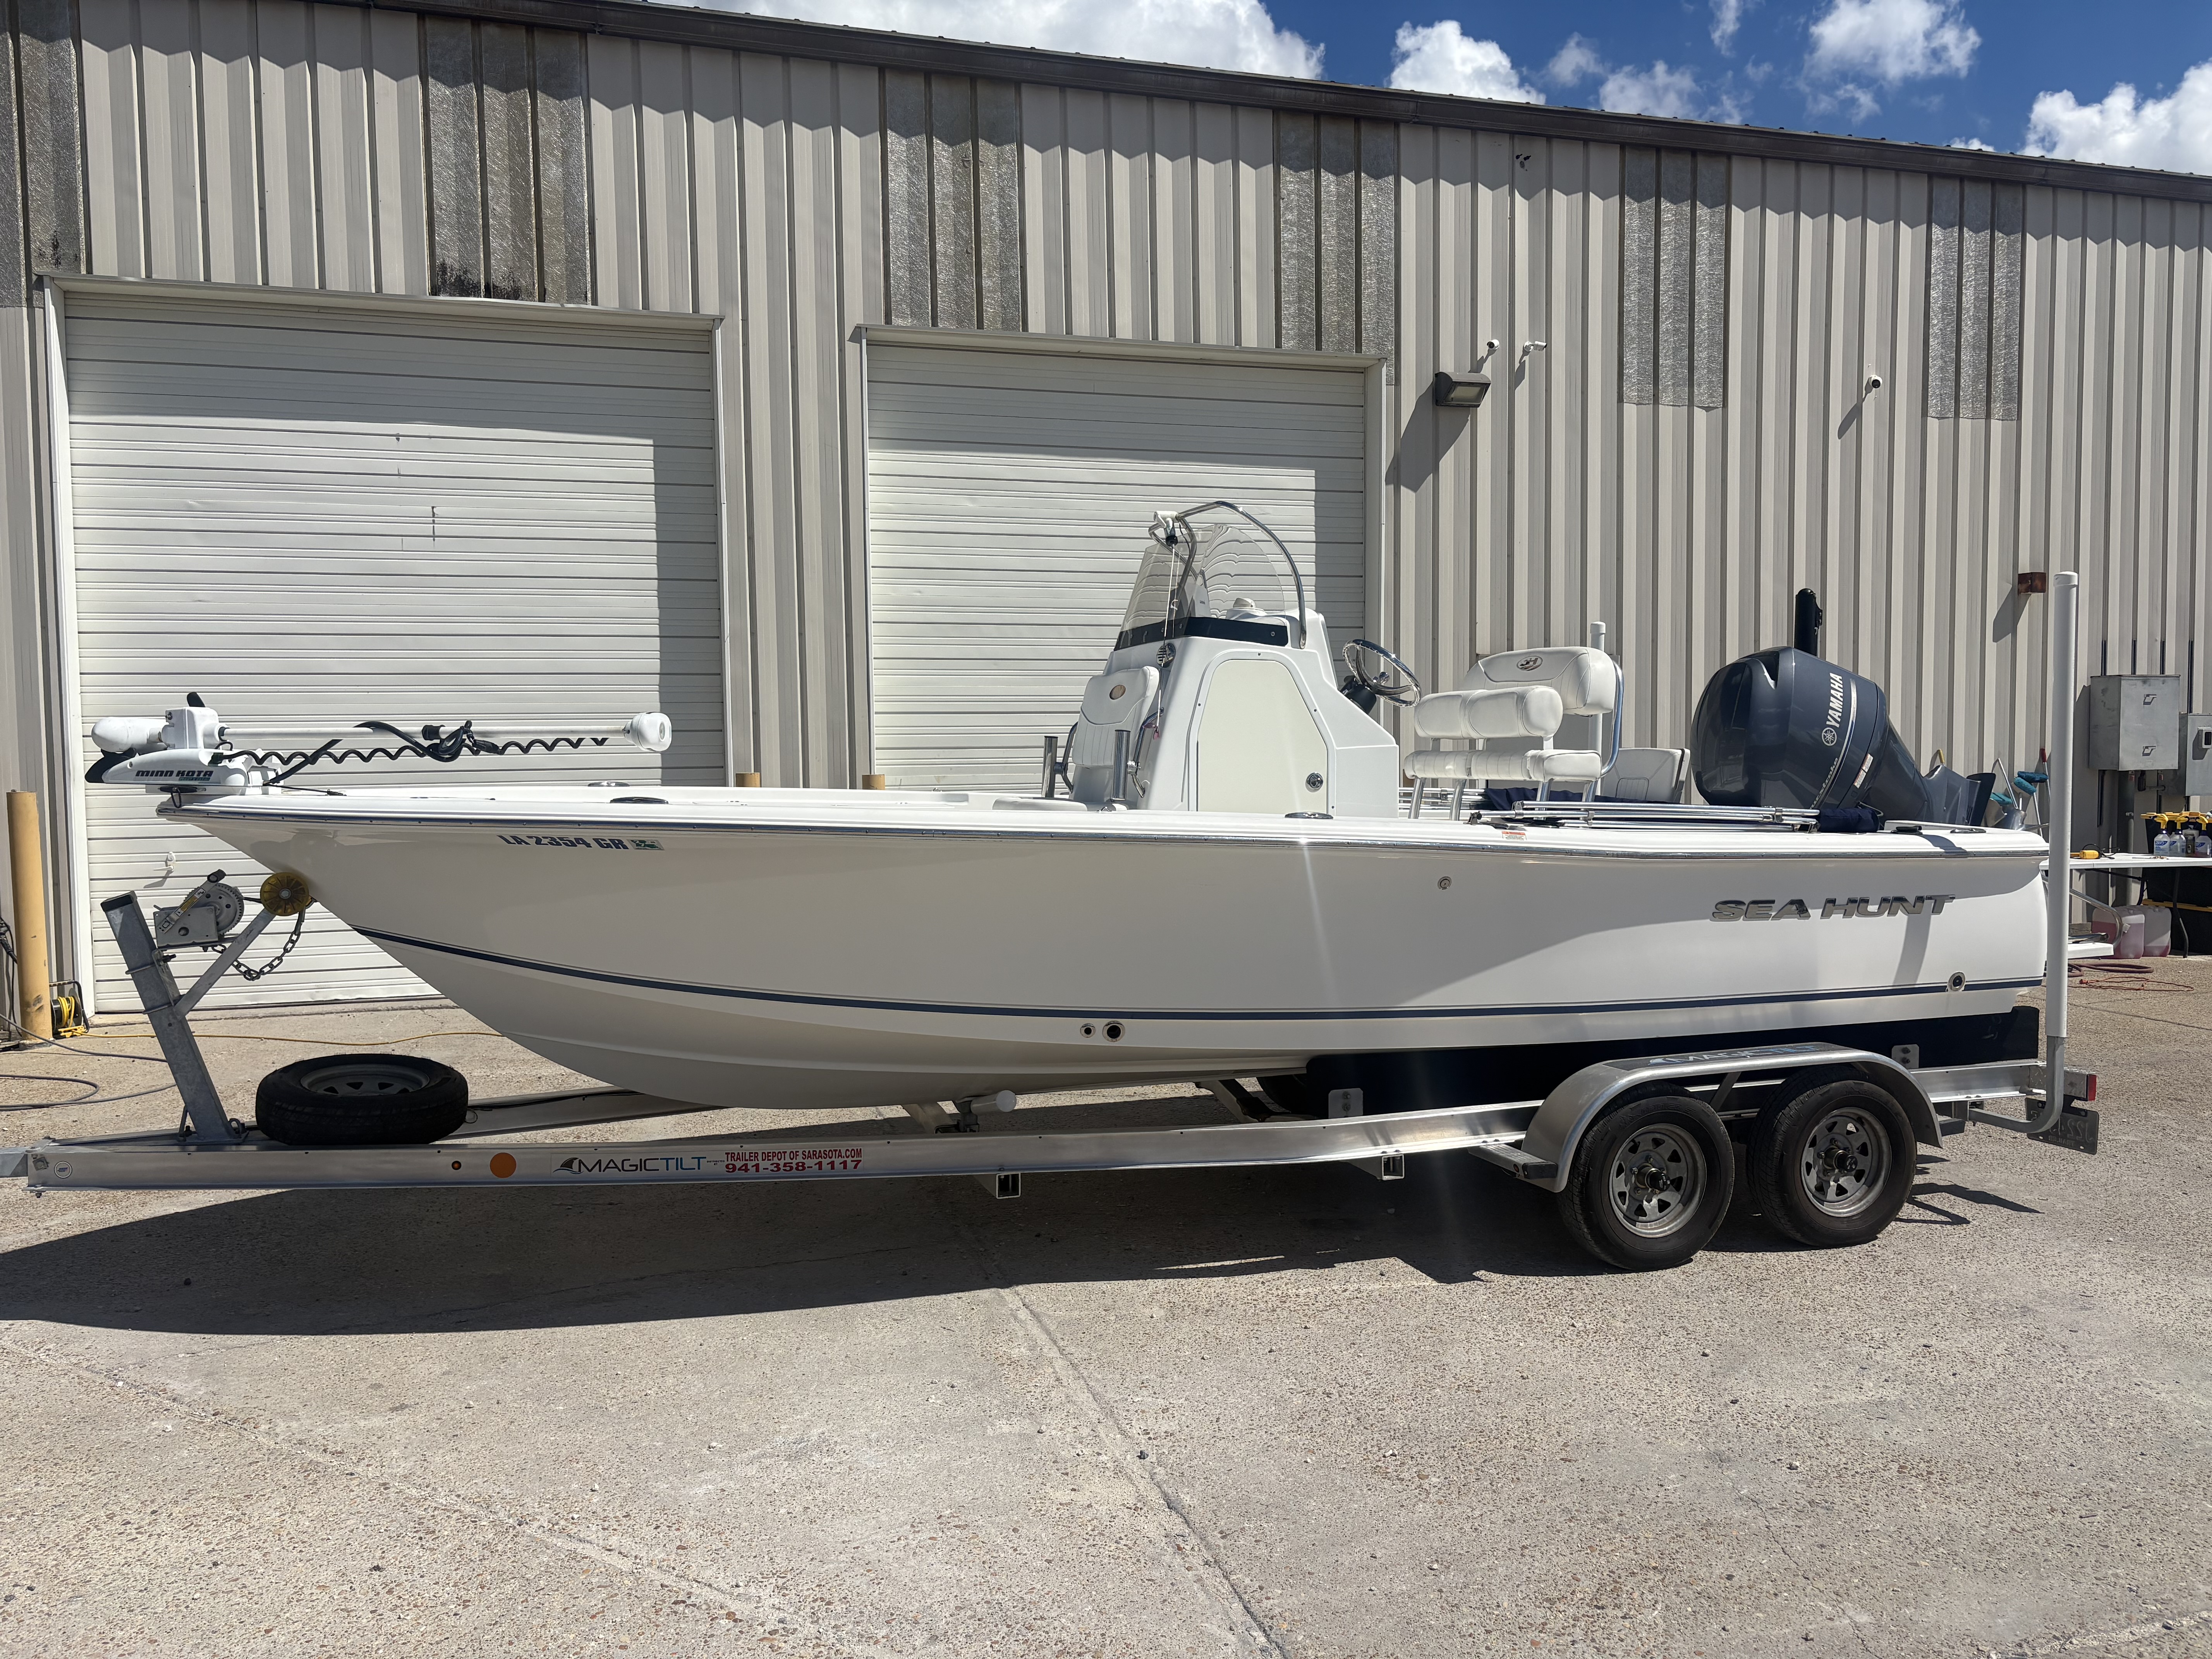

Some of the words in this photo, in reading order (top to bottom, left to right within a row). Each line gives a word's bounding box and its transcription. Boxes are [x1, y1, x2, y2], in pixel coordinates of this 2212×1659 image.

[1826, 673, 1843, 728] YAMAHA
[496, 835, 531, 845] LA
[527, 836, 592, 848] 2354
[592, 838, 629, 850] GR
[1711, 899, 1811, 920] SEA
[1820, 895, 1956, 919] HUNT
[1665, 1046, 1820, 1062] MAGICTILT
[725, 1152, 759, 1162] TRAILER
[762, 1151, 787, 1161] DEPOT
[789, 1150, 799, 1161] OF
[802, 1148, 862, 1160] SARASOTA.COM
[578, 1156, 706, 1172] MAGICTILT
[725, 1159, 862, 1173] 941-358-1117
